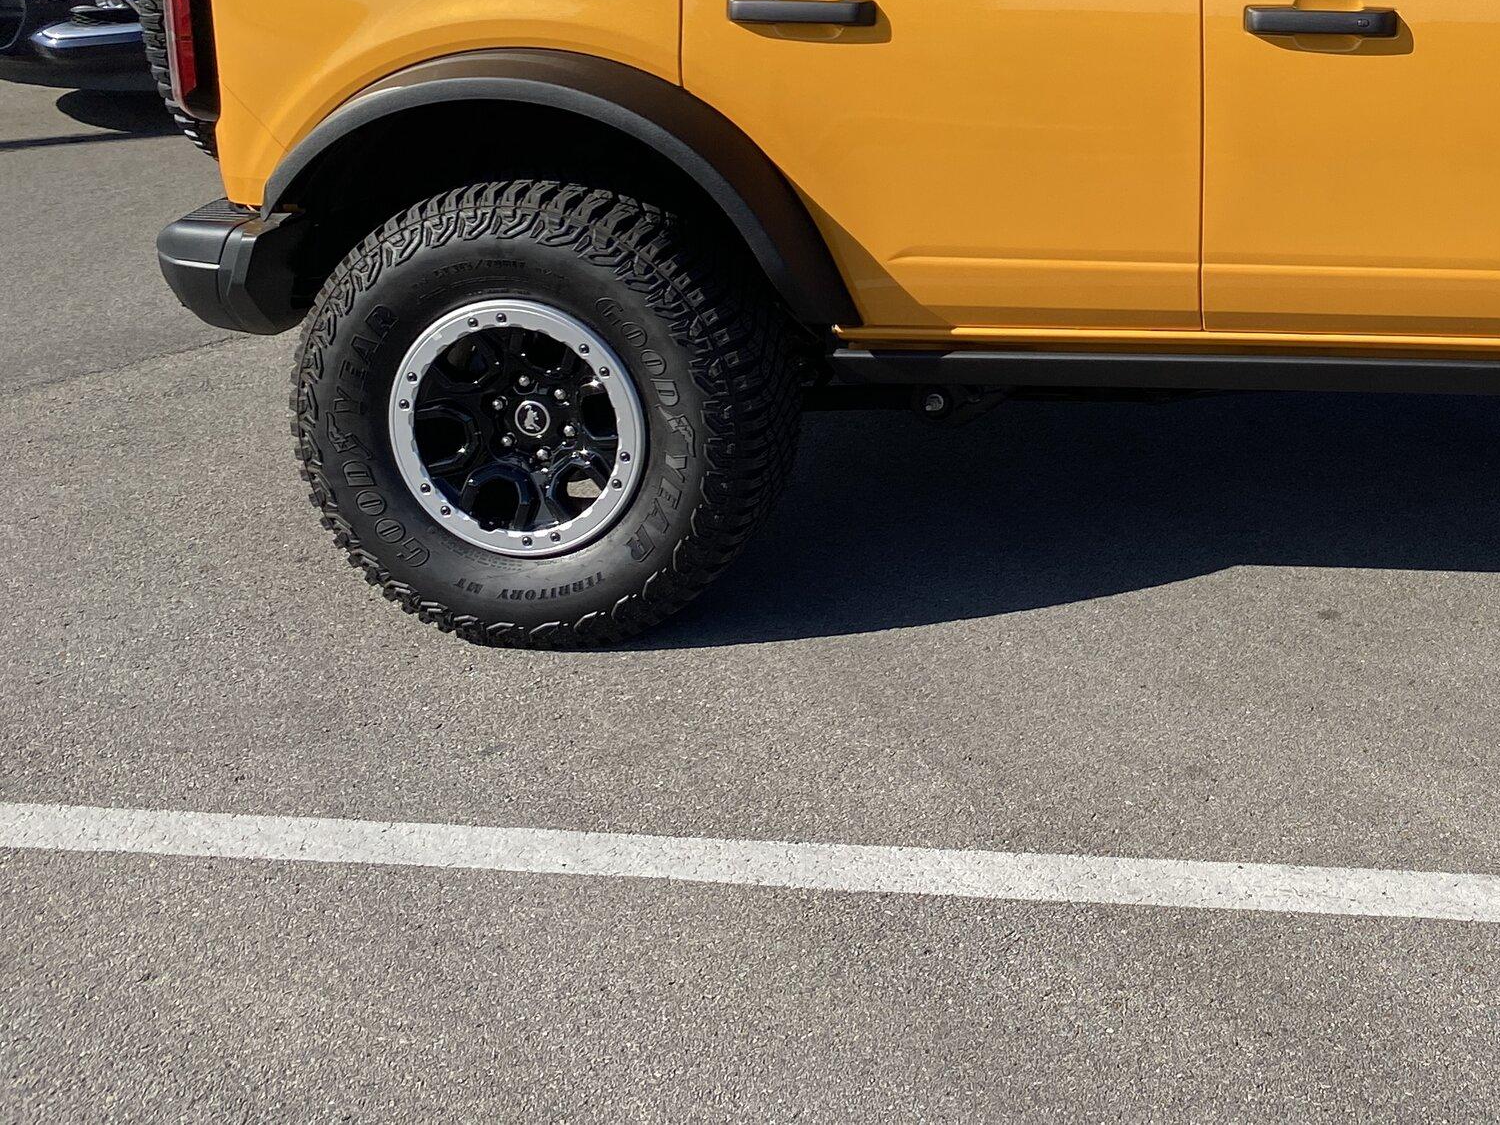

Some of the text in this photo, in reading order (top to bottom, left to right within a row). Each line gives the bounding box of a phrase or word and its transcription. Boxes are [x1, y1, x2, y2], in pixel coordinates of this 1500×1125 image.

[326, 304, 430, 567] GOODYEAR
[595, 297, 697, 563] GOODYEAR
[453, 571, 606, 601] TERRITORY MT
